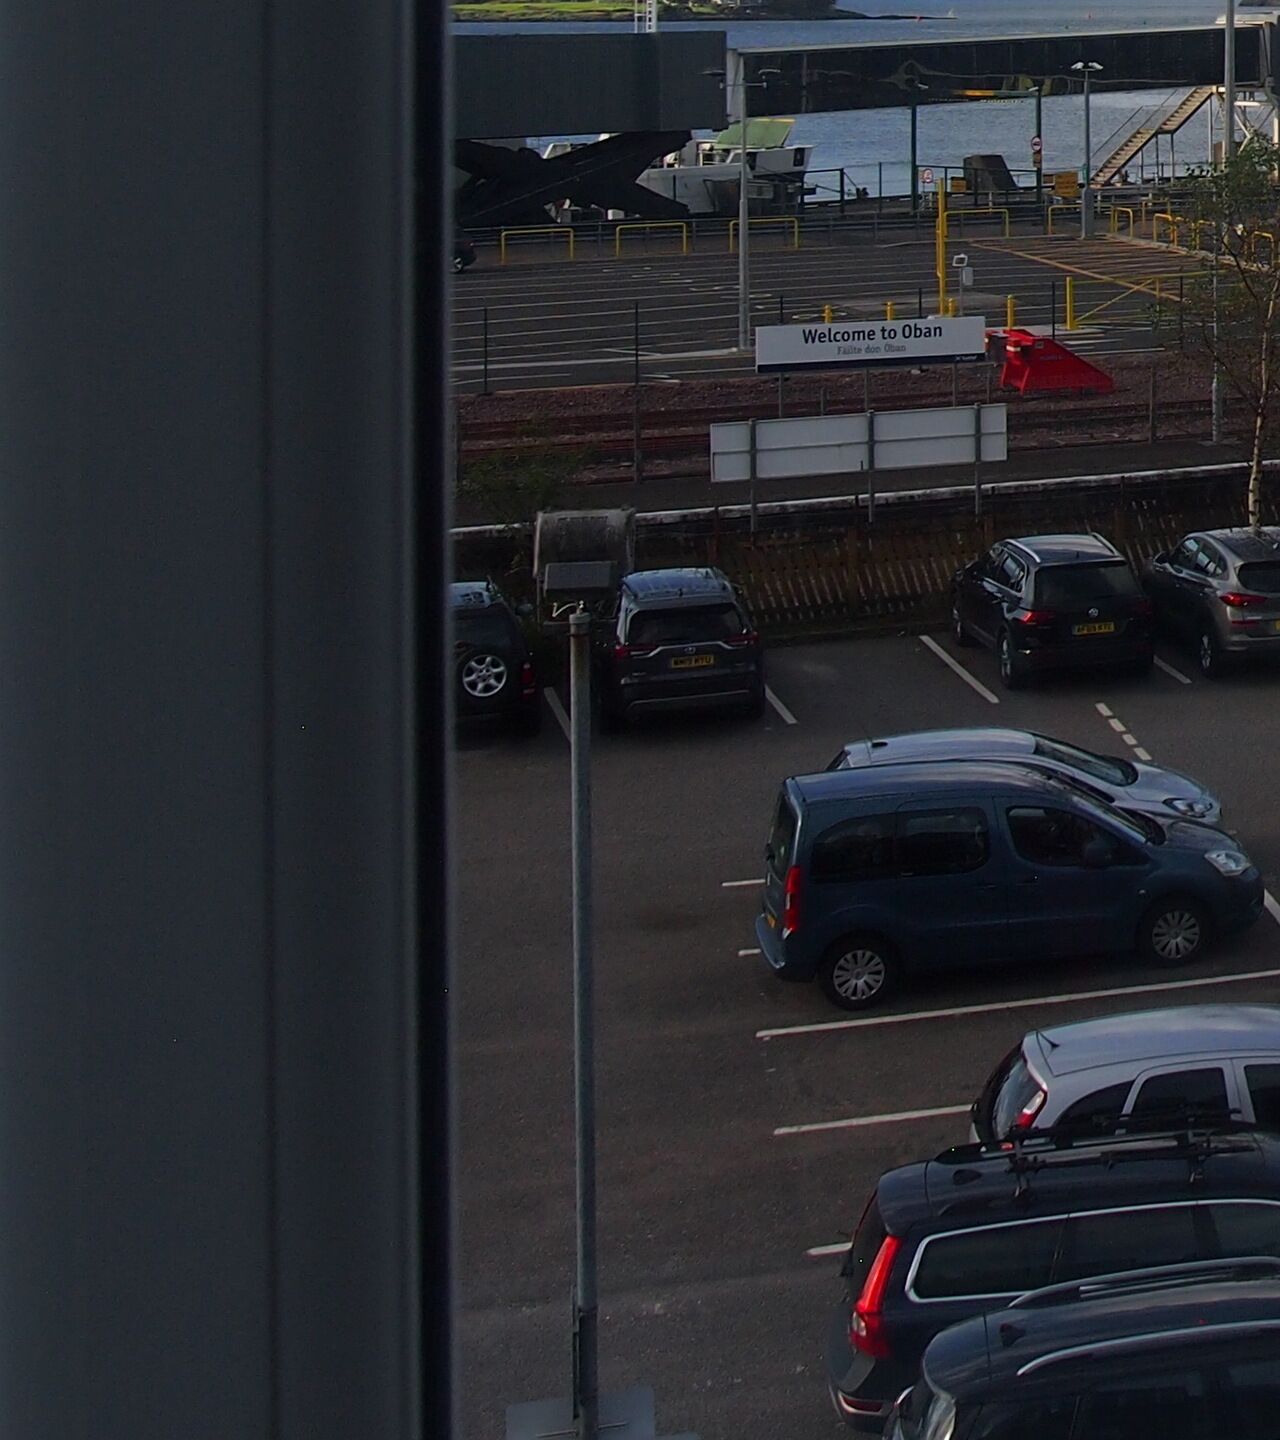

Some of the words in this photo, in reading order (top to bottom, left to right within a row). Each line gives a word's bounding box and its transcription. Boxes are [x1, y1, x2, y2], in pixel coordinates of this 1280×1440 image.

[802, 327, 876, 344] Welcome
[881, 326, 897, 340] to
[902, 323, 943, 339] Oban
